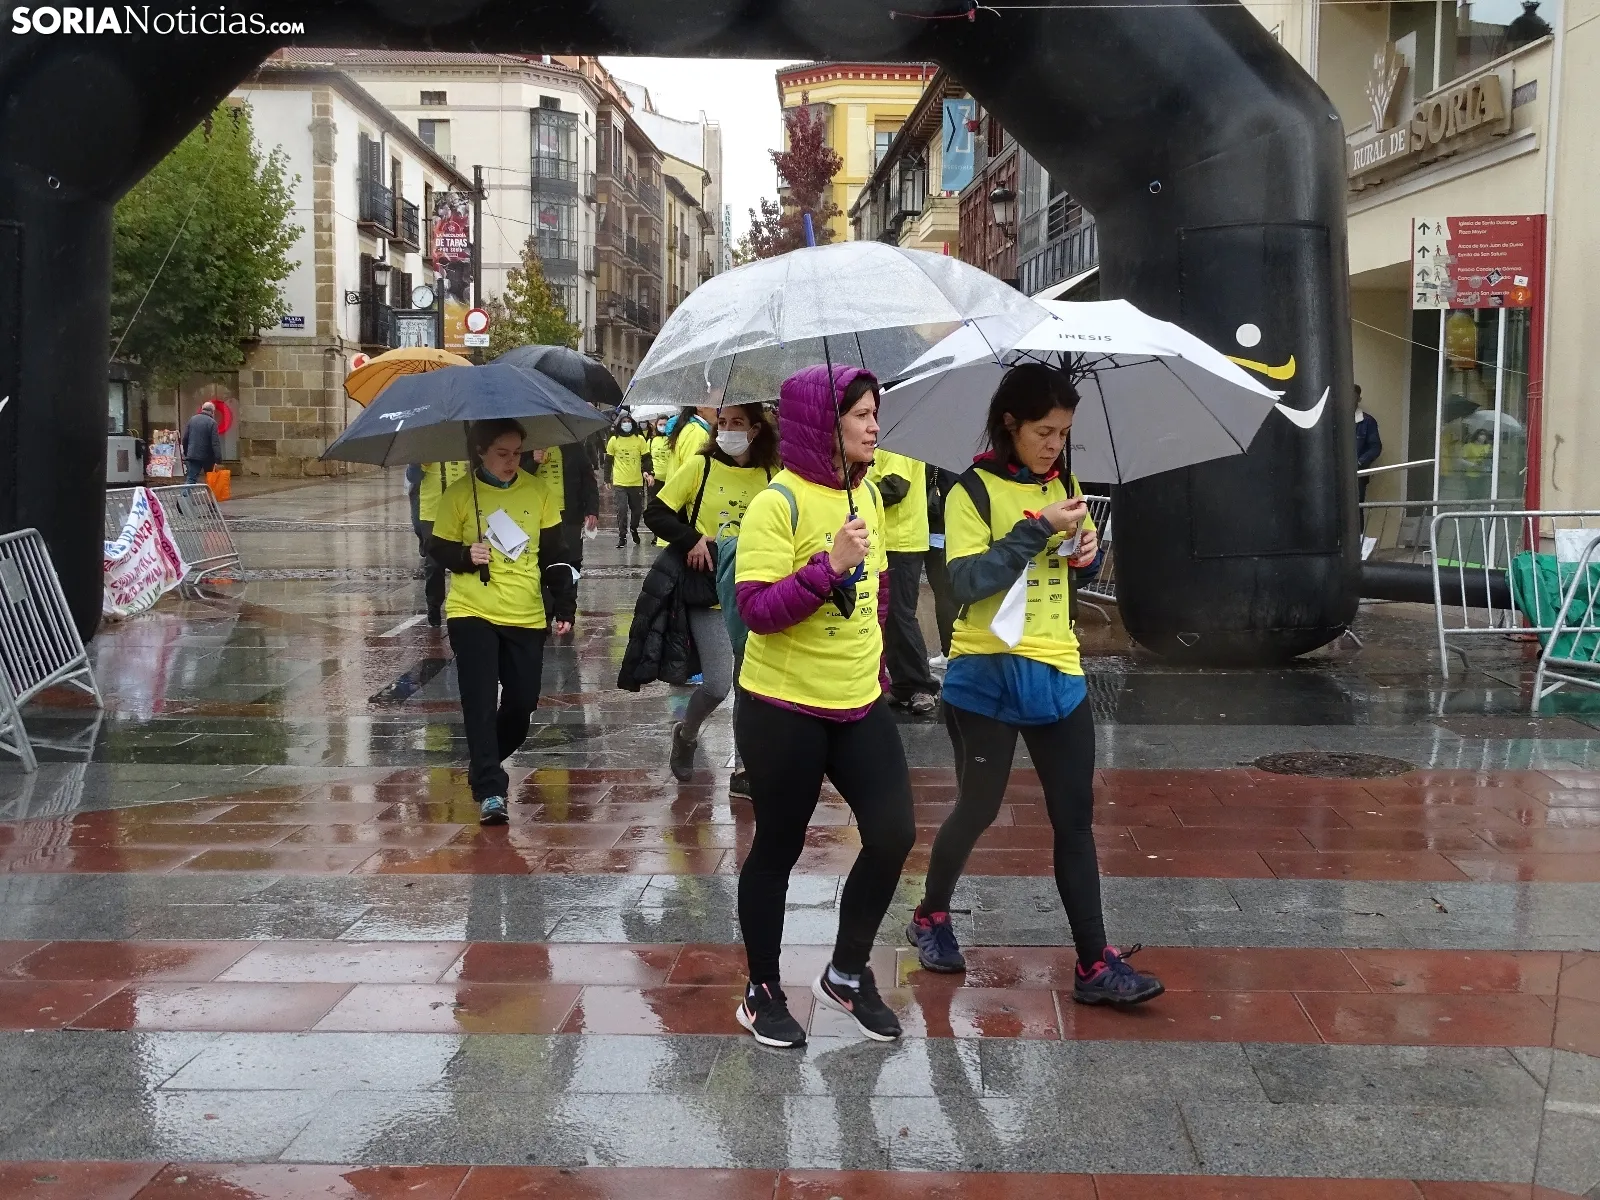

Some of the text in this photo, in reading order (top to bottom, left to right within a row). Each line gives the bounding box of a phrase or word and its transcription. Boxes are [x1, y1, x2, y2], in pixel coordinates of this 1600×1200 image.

[1353, 75, 1503, 170] RURAL DE SORIA
[435, 238, 468, 247] DE TAPAS
[1517, 291, 1524, 301] 2
[1058, 333, 1113, 342] INESIS
